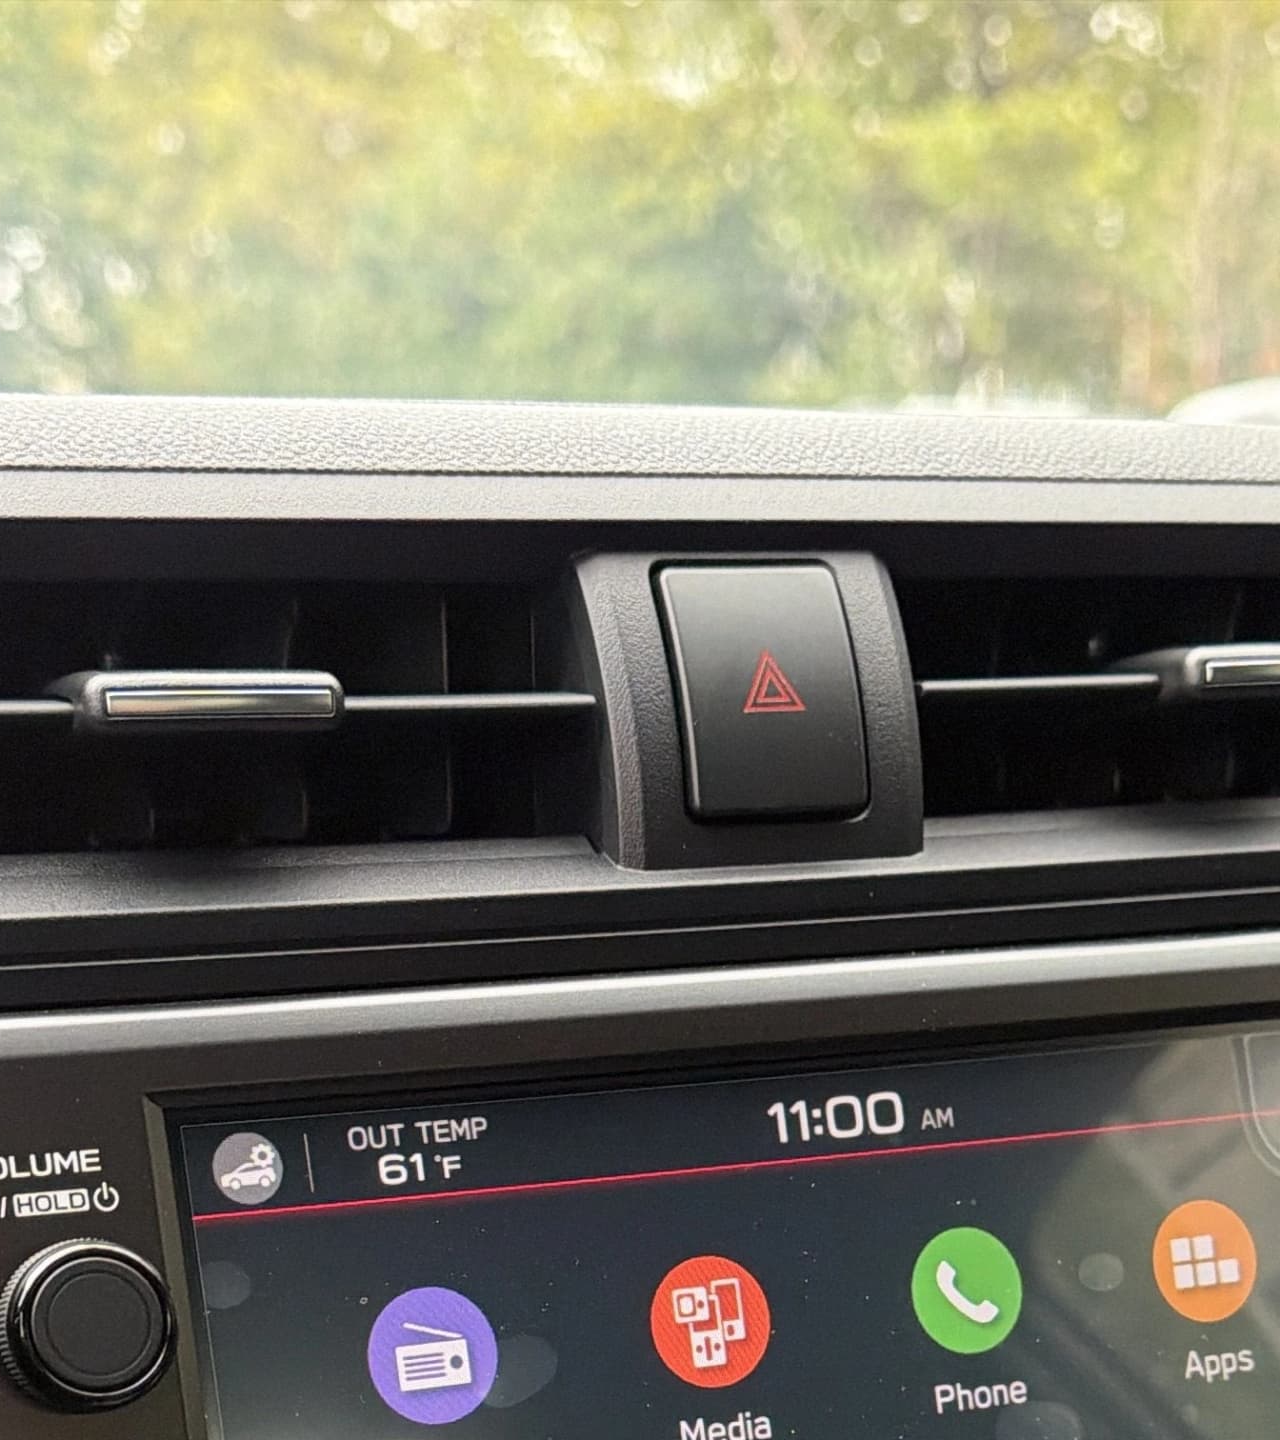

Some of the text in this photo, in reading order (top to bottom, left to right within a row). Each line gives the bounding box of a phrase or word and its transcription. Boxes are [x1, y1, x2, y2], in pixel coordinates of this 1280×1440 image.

[347, 1116, 488, 1151] OUT TEMP
[767, 1091, 955, 1143] 11:00 AM
[1185, 1349, 1255, 1383] Apps
[934, 1380, 1027, 1414] Phone
